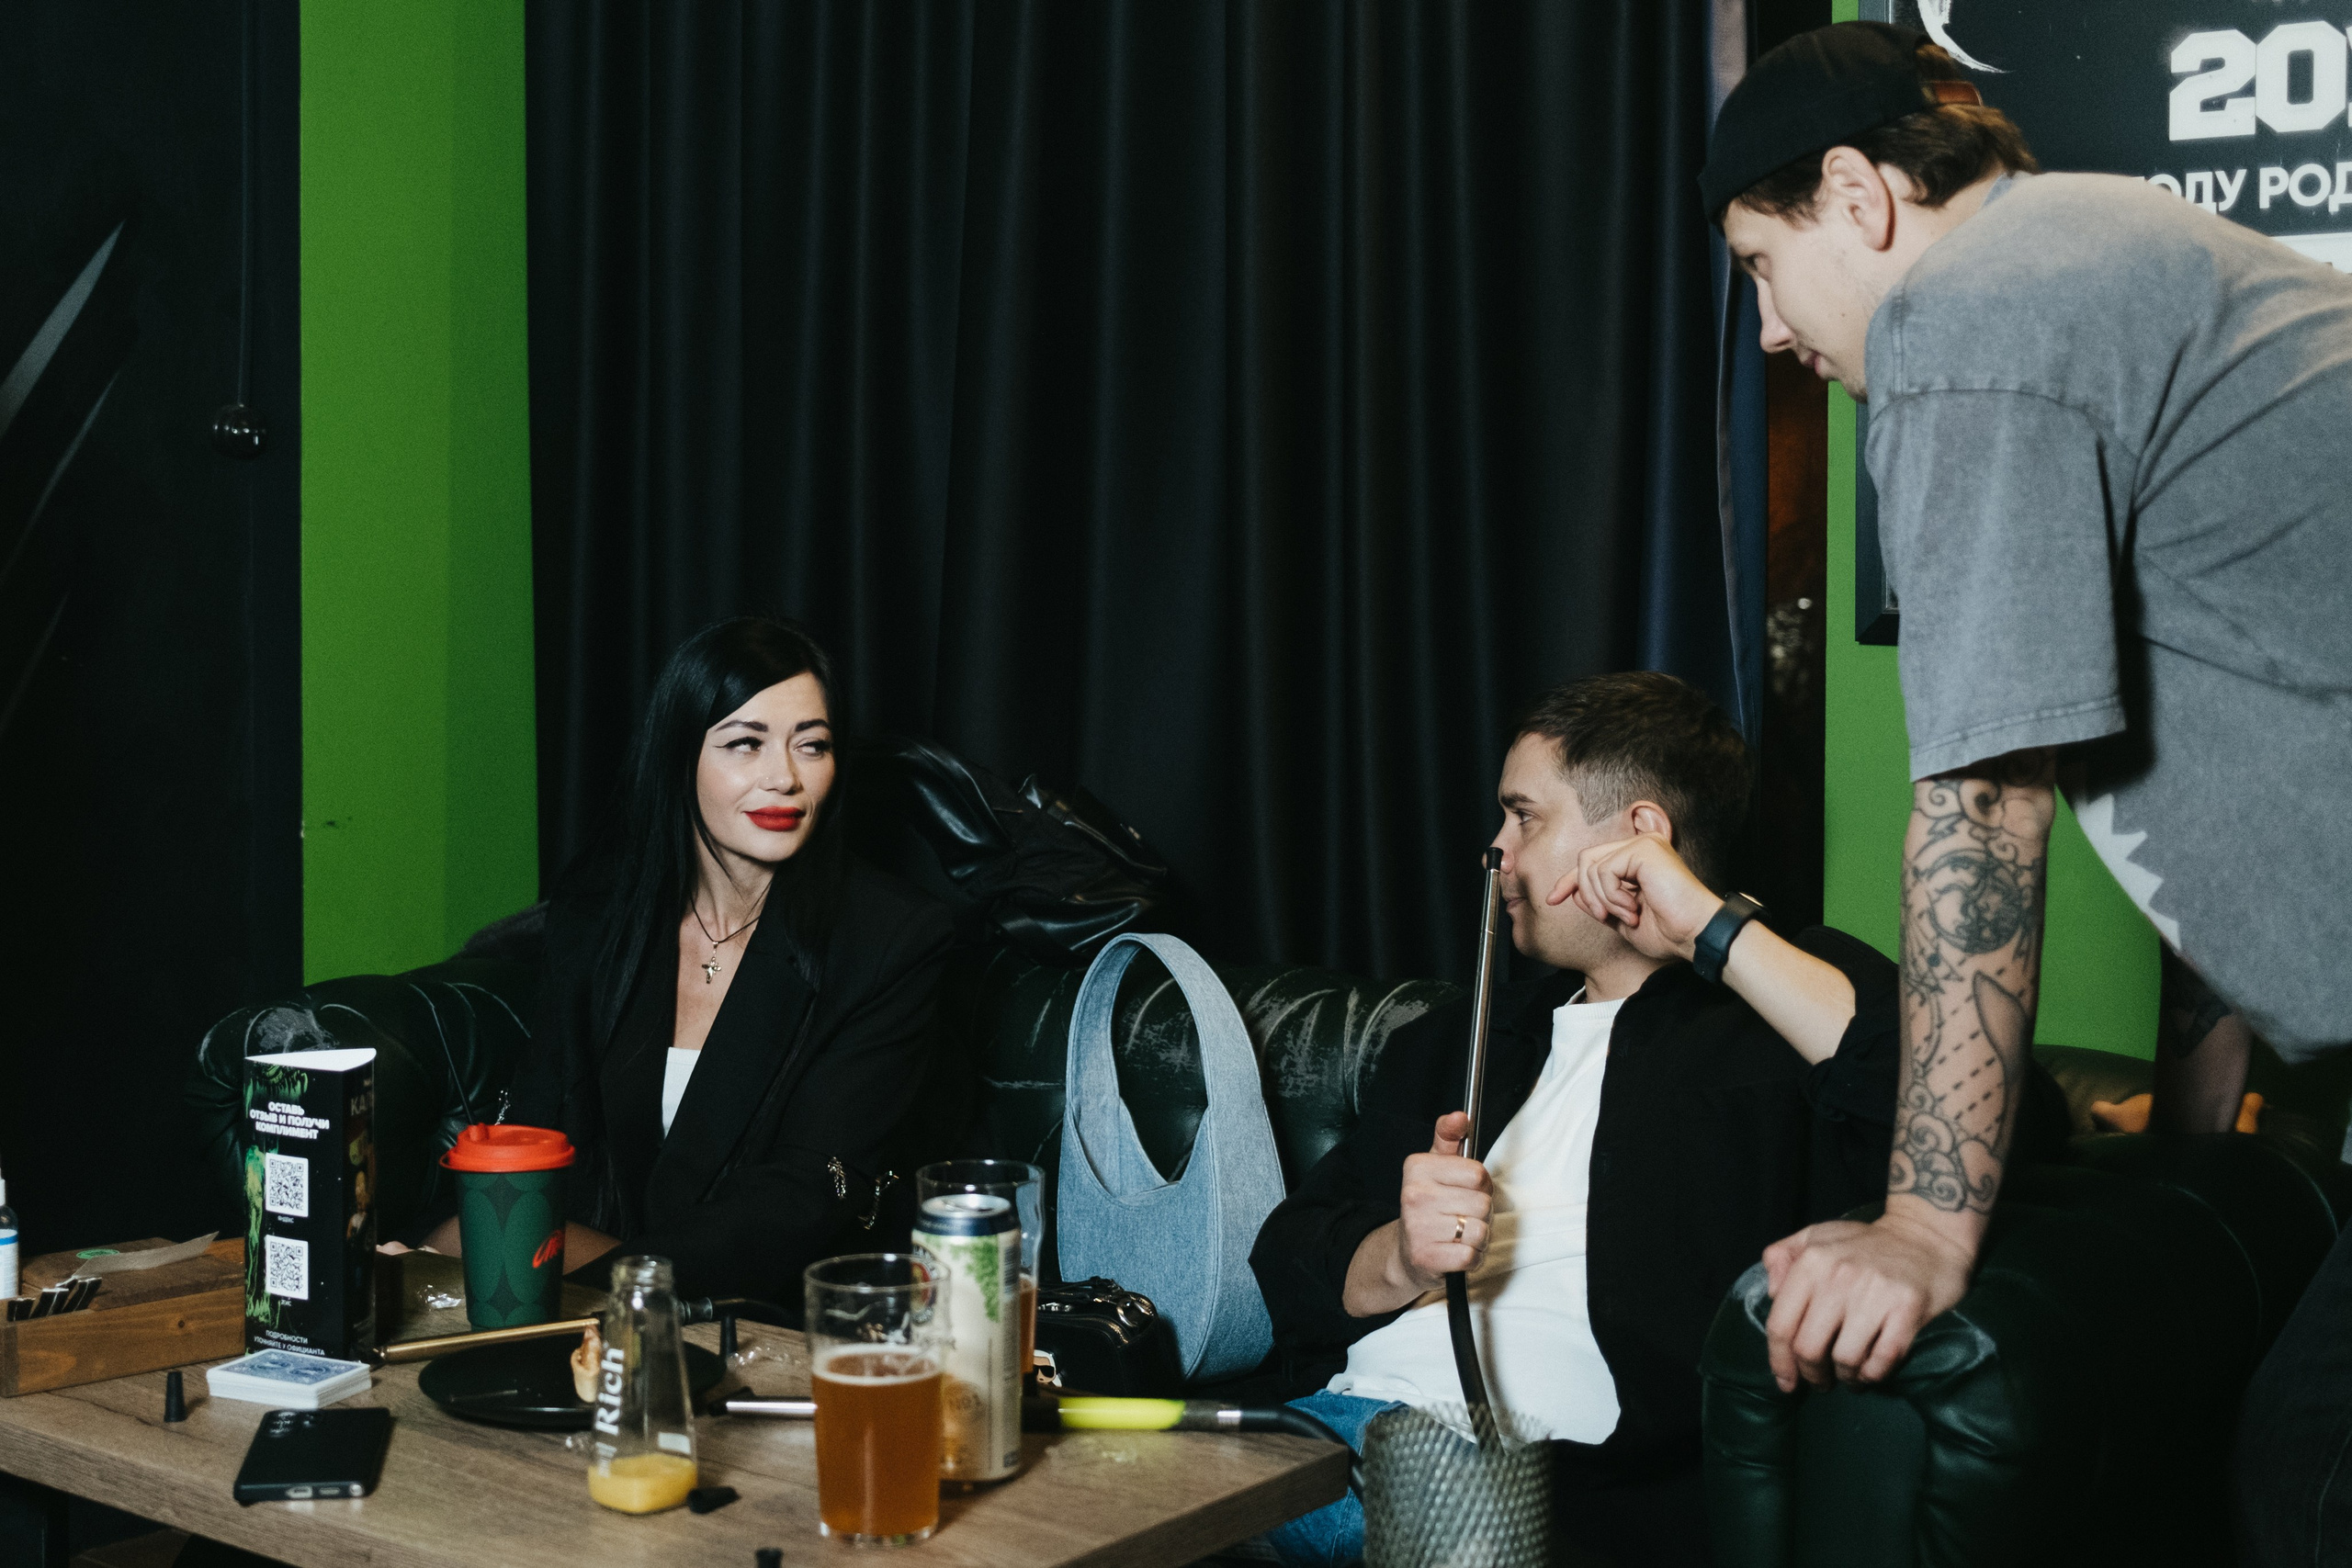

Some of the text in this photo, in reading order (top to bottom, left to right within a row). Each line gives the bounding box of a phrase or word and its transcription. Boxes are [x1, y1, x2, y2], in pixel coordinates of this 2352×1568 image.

[2169, 20, 2352, 141] 20
[2132, 168, 2247, 215] ДУ
[267, 1101, 305, 1115] ОСТАВЬ
[249, 1109, 330, 1130] ОТЗЫВ И ПОЛУЧИ
[255, 1121, 319, 1139] КОМПЛИМЕНТ
[266, 1329, 308, 1344] ПОДРОБНОСТИ
[287, 1344, 325, 1356] ОФИЦИАНТА
[595, 1348, 625, 1437] Rich
